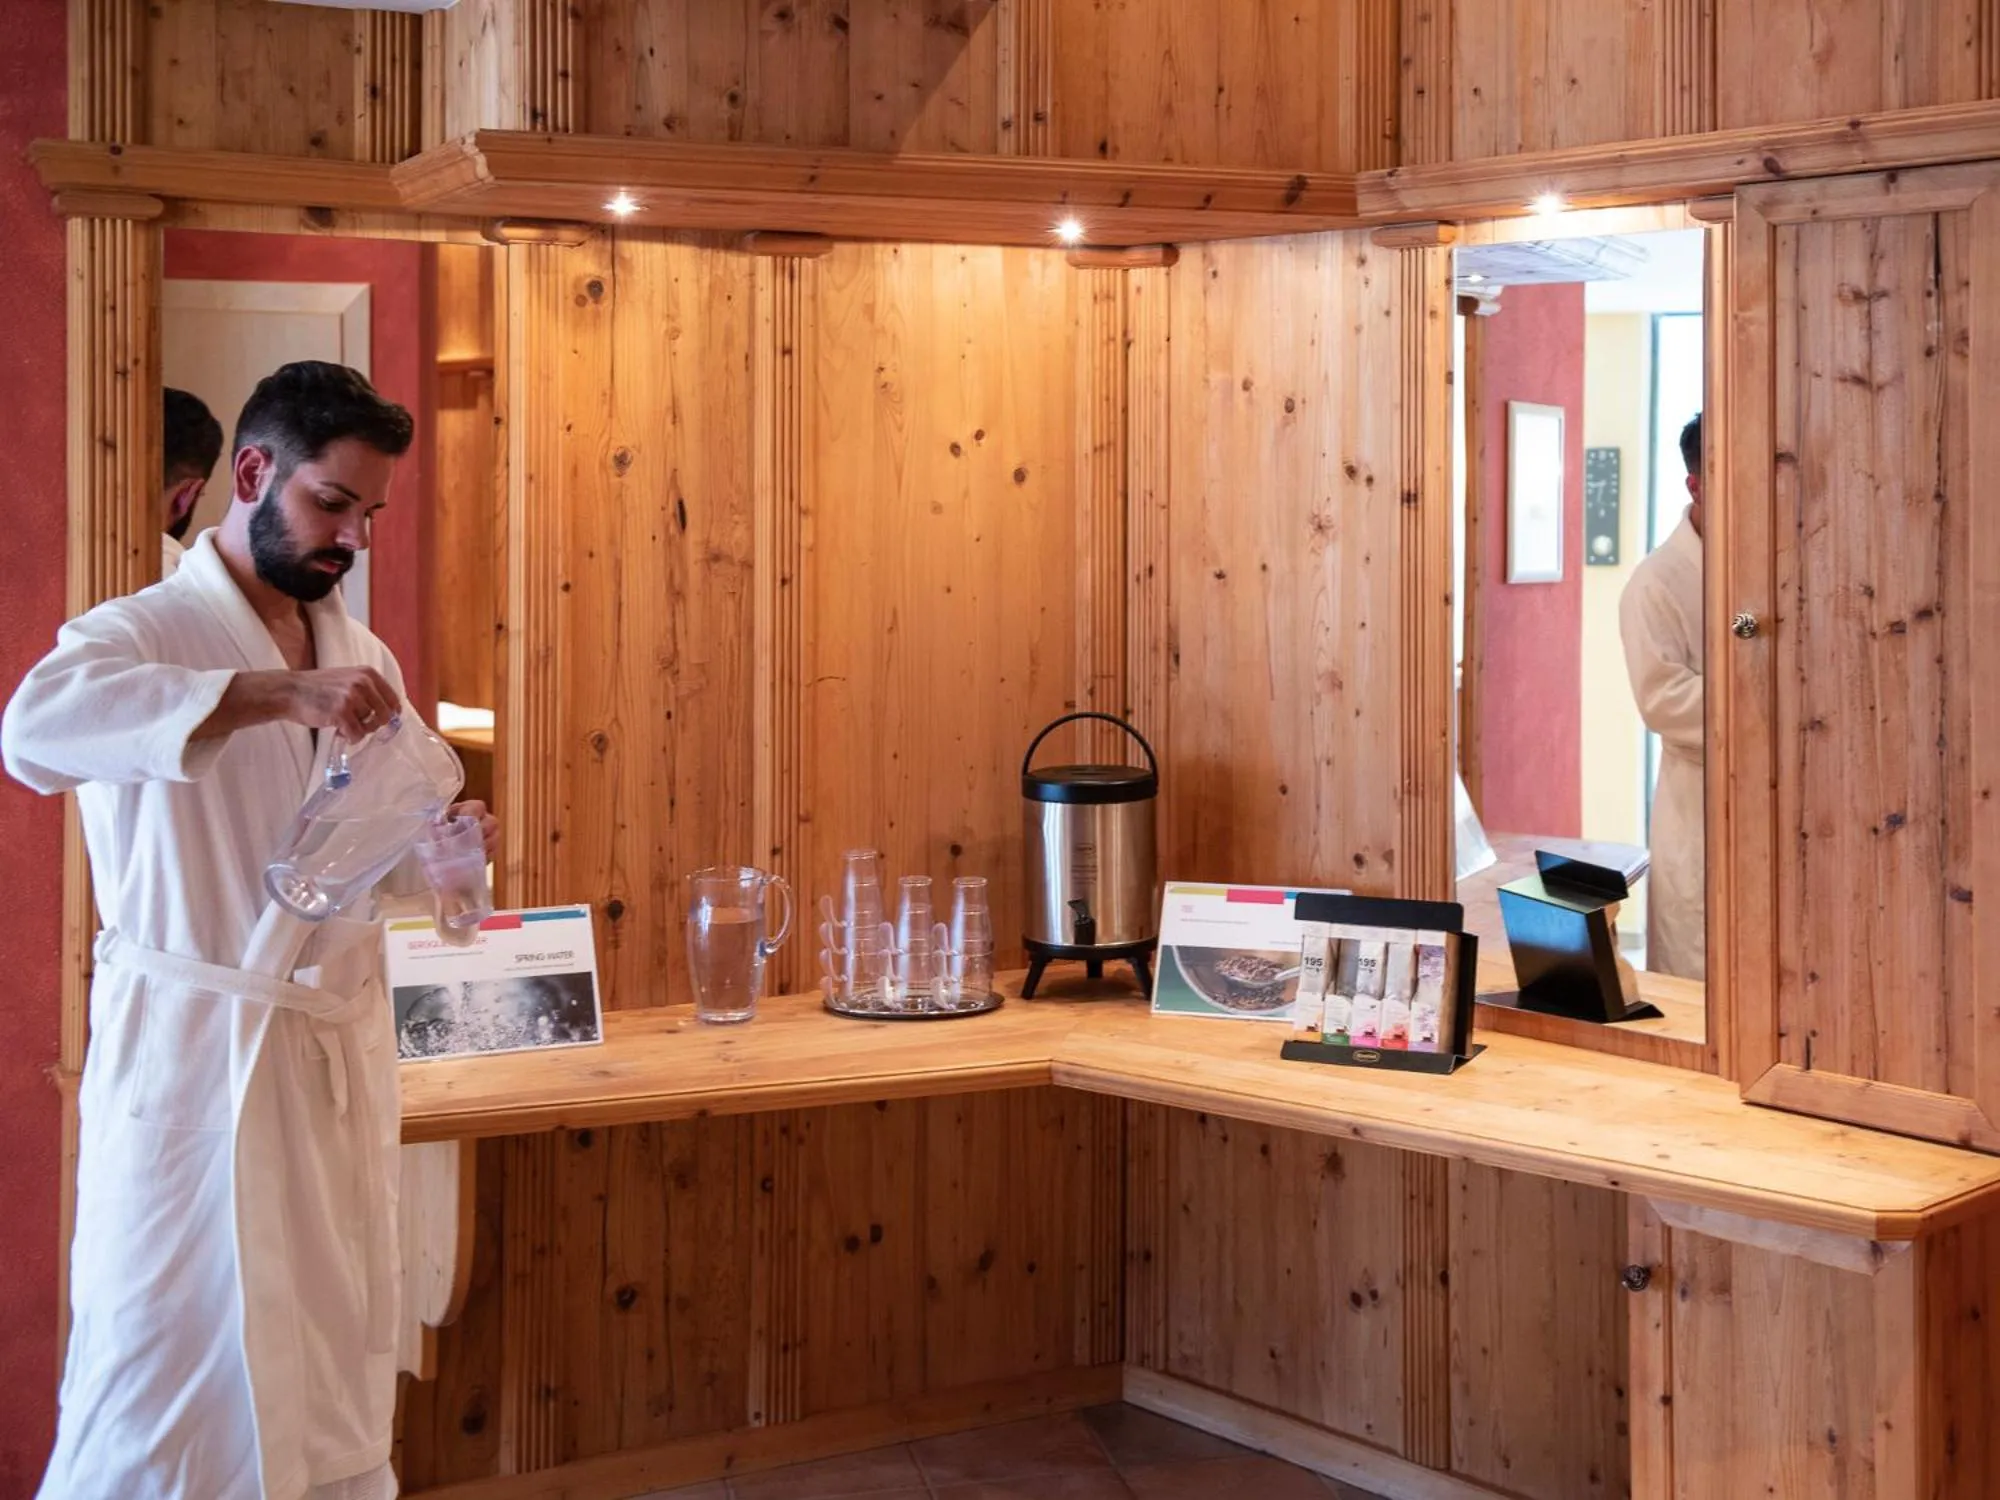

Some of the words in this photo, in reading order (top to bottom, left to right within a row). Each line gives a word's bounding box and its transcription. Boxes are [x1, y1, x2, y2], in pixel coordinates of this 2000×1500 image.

[515, 952, 545, 963] SPRING
[547, 950, 574, 960] WATER
[1304, 956, 1323, 967] 195
